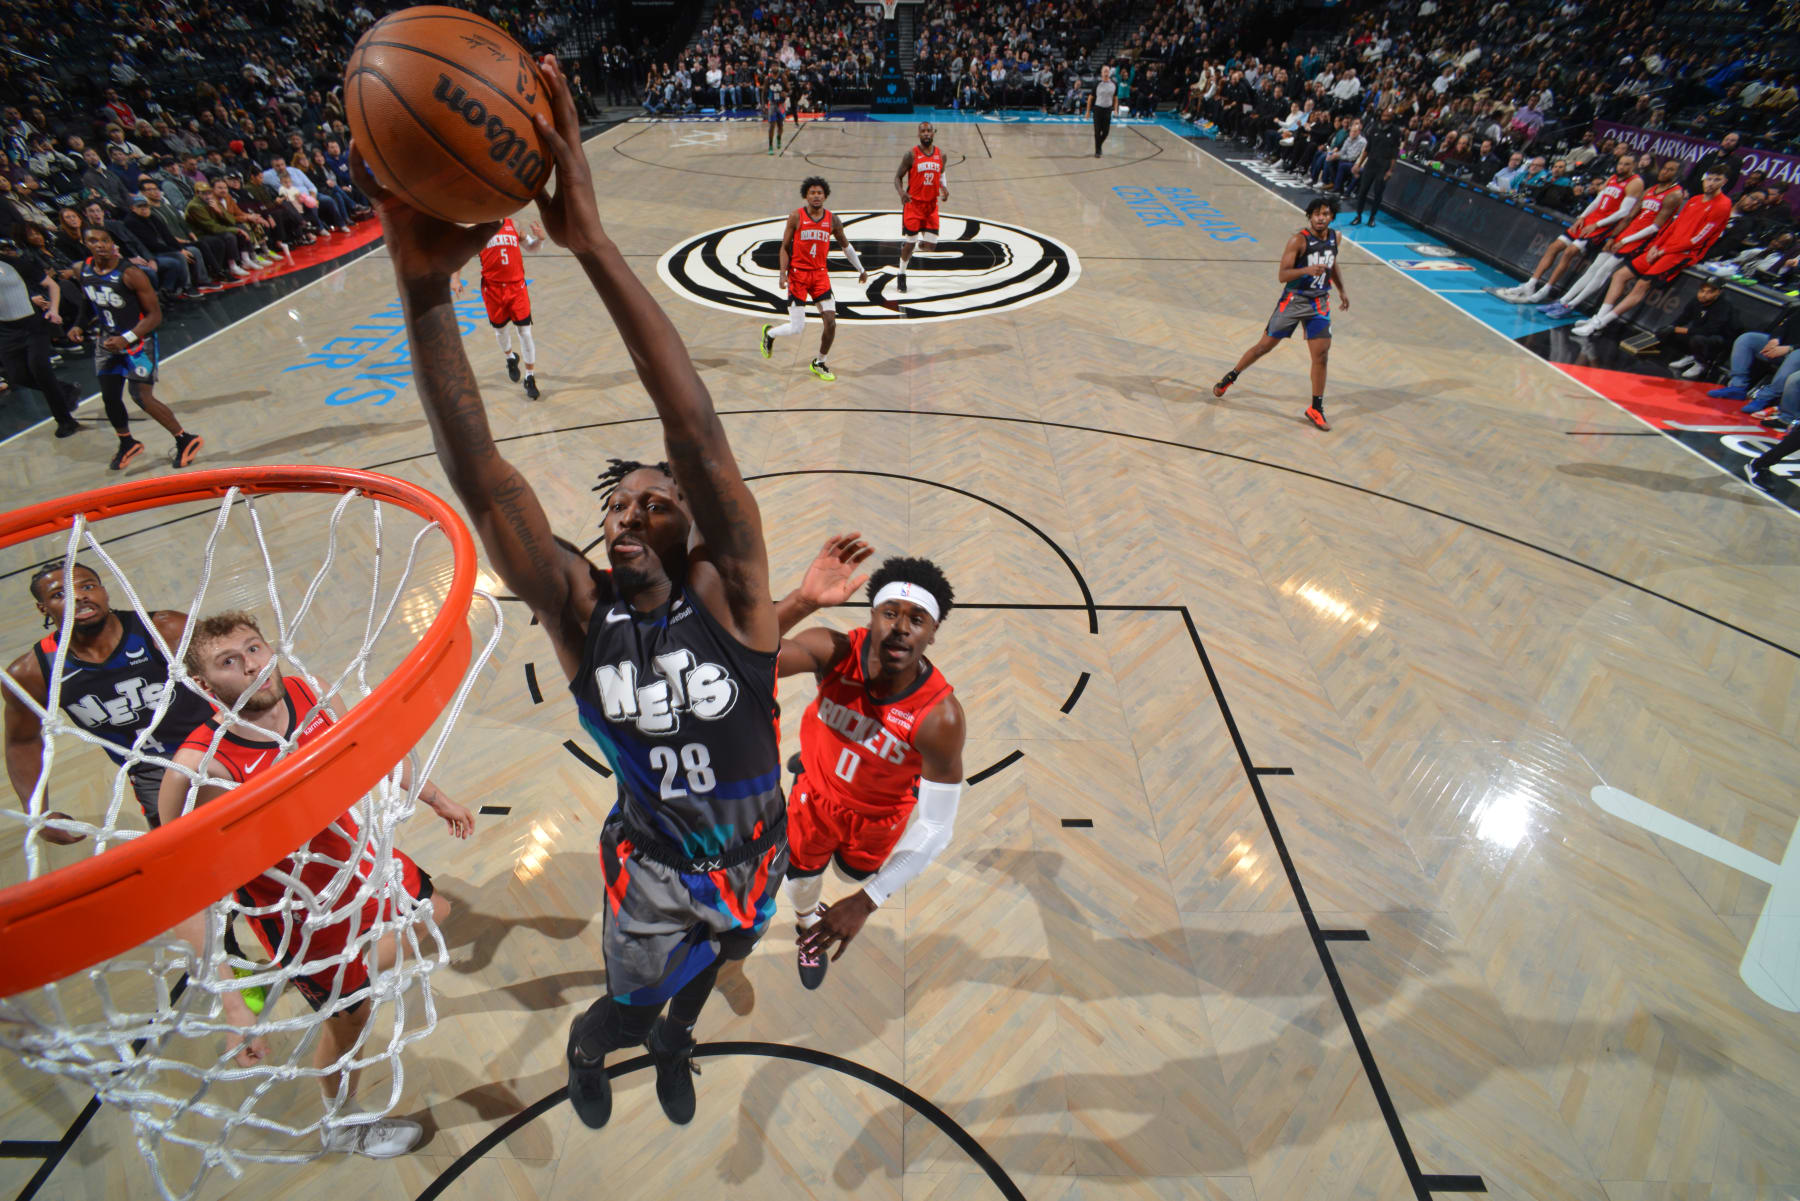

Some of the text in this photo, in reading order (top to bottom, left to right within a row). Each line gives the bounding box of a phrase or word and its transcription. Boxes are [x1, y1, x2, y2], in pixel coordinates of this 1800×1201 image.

[432, 72, 545, 191] Wilson
[917, 161, 940, 173] ROCKETS
[923, 172, 935, 186] 32
[1112, 185, 1185, 227] CENTER
[1155, 186, 1259, 242] BARCLAYS
[800, 229, 830, 243] ROCKETS
[500, 248, 509, 265] 5
[809, 243, 817, 259] 4
[1307, 249, 1336, 269] NETS
[1310, 272, 1327, 289] 24
[84, 285, 124, 309] NETS
[596, 648, 739, 735] NETS
[67, 676, 177, 728] NETS
[886, 712, 911, 731] karma
[890, 707, 915, 723] credit
[303, 717, 324, 735] karma
[817, 696, 910, 765] ROCKETS
[649, 742, 716, 801] 28
[835, 747, 861, 783] 0
